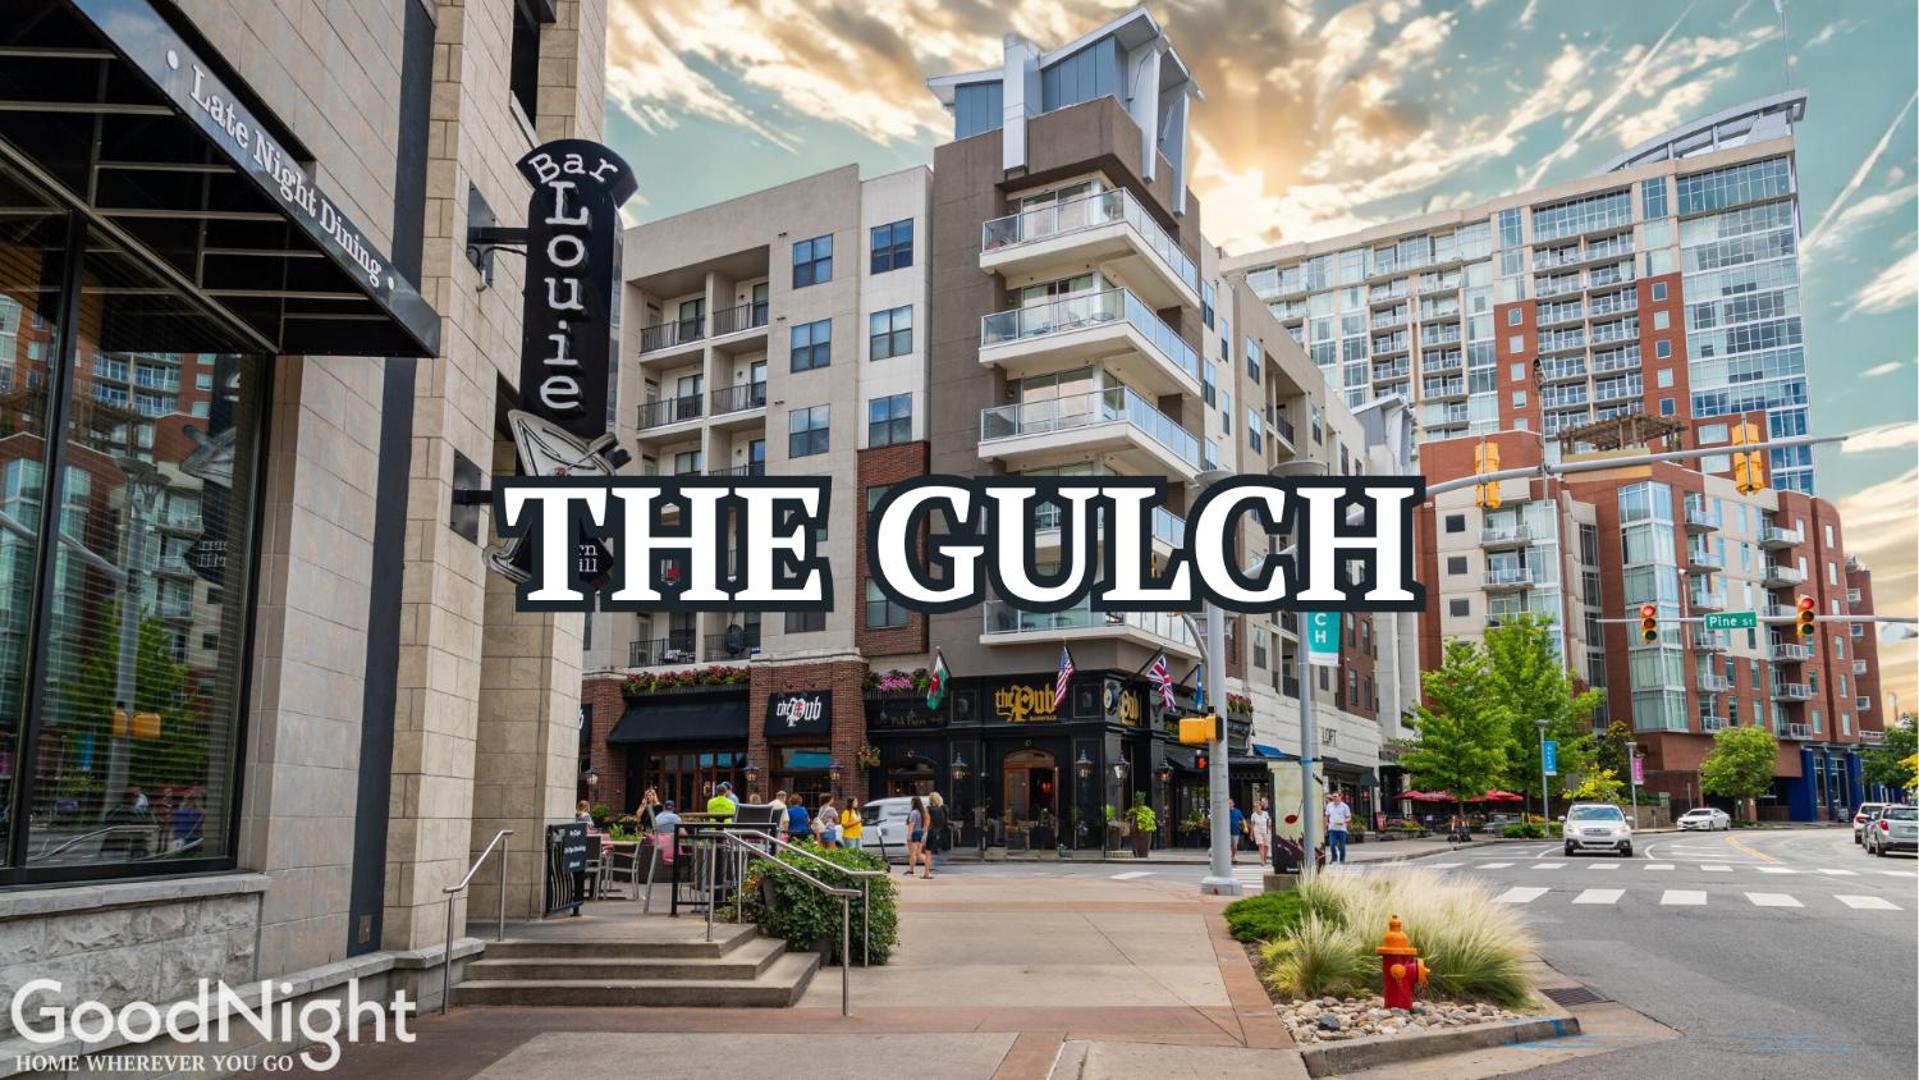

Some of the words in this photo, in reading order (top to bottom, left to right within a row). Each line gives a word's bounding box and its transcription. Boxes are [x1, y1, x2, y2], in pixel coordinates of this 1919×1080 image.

[190, 64, 249, 149] Late
[253, 130, 317, 218] Night
[320, 199, 382, 288] Dining
[528, 153, 619, 184] Bar
[539, 181, 589, 409] Louie
[1709, 616, 1737, 627] Pine
